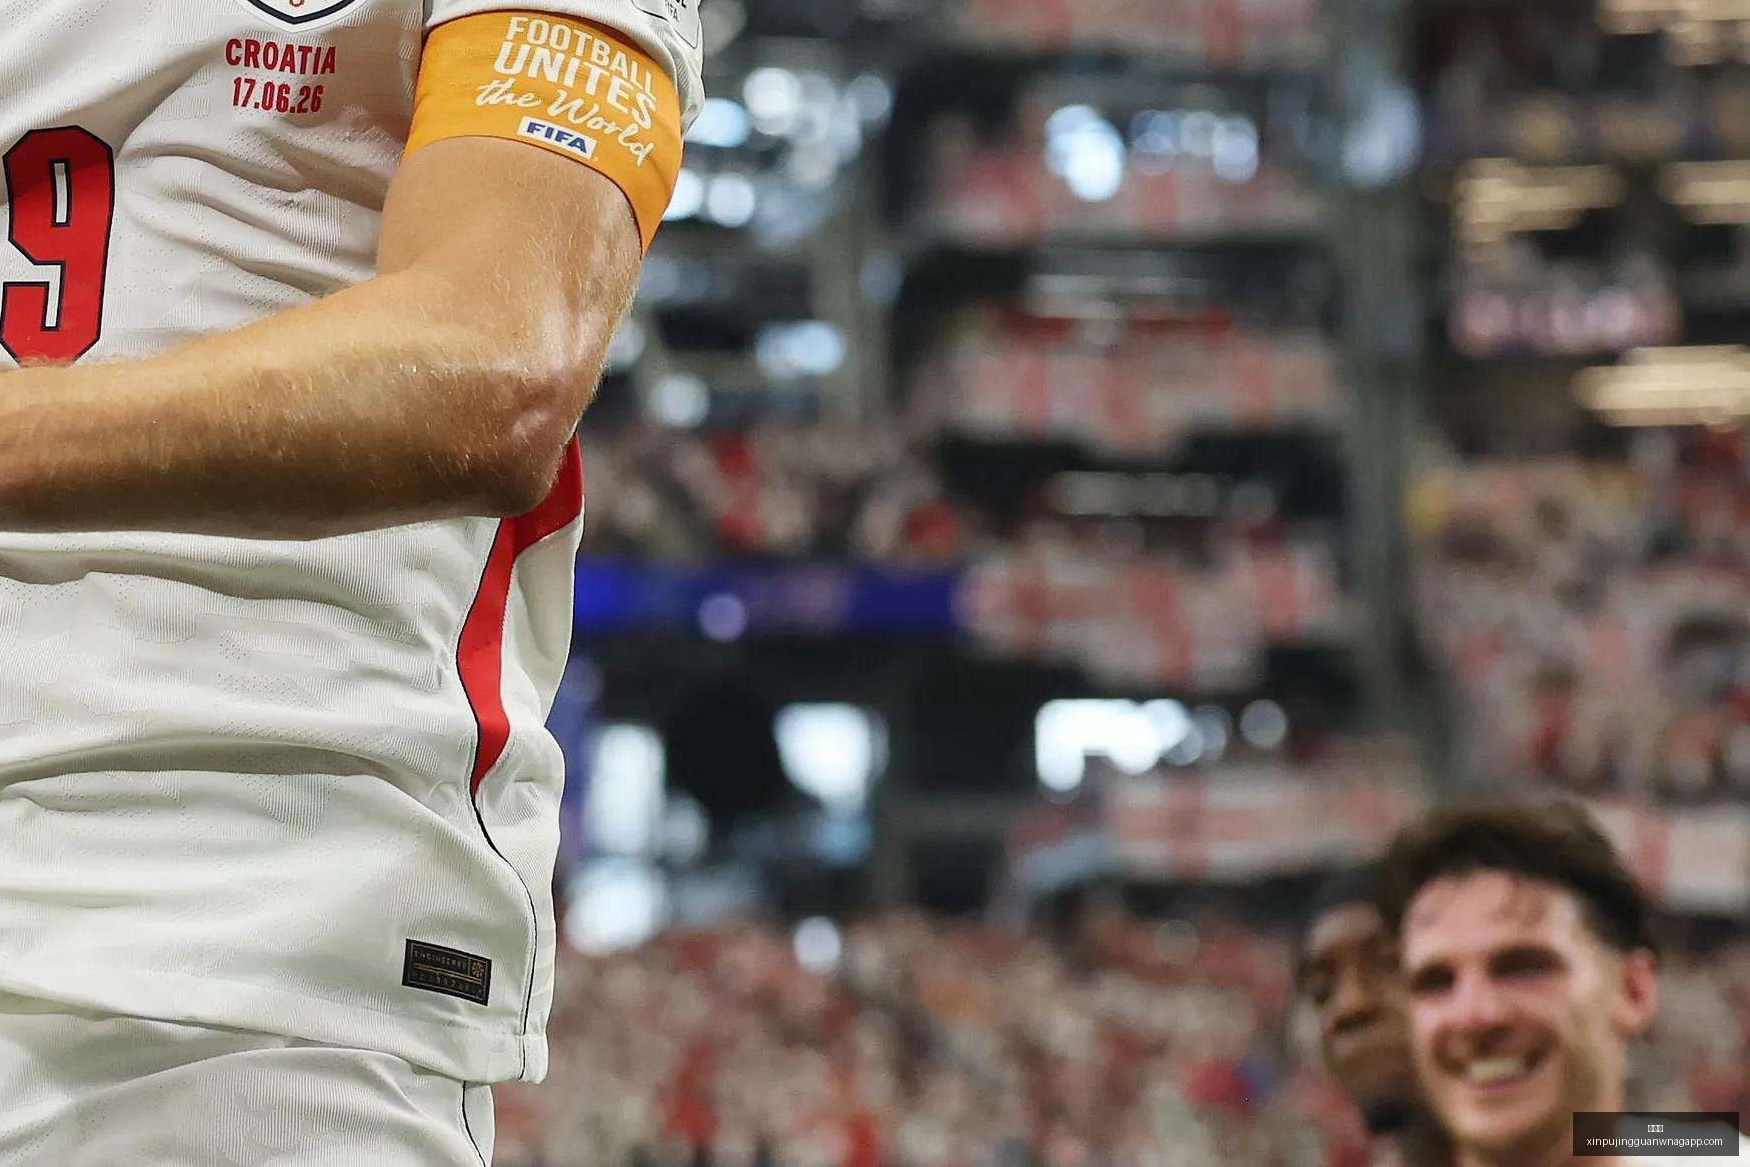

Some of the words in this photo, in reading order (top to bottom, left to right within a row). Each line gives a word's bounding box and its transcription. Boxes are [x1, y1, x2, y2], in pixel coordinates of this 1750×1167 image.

[225, 38, 337, 75] CROATIA
[493, 41, 658, 130] UNITES
[505, 16, 658, 102] FOOTBALL
[232, 77, 324, 114] 17.06.26
[475, 78, 542, 107] the
[547, 89, 655, 167] World
[525, 121, 588, 154] FIFA
